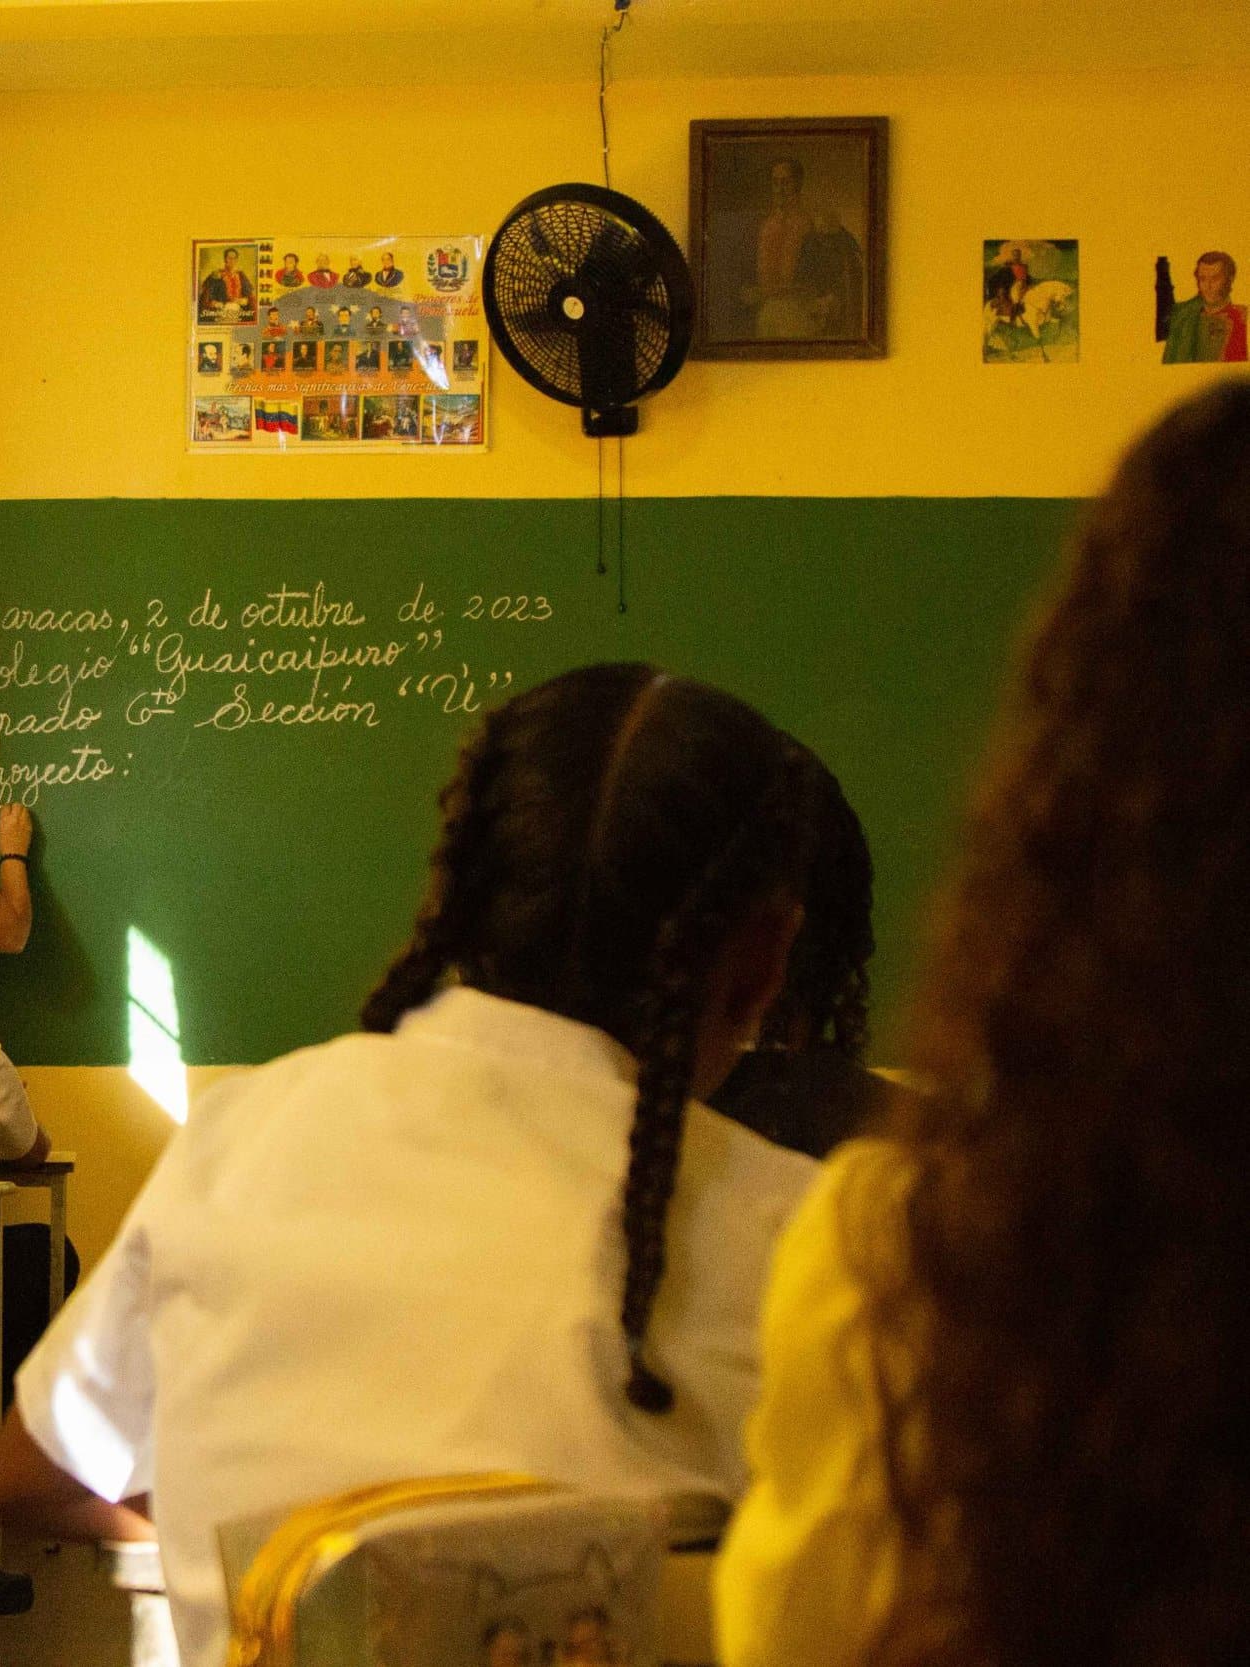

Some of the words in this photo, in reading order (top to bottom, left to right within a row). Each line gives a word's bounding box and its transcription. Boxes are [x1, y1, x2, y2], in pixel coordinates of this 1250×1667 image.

[146, 599, 168, 628] 2
[189, 588, 228, 630] de
[241, 580, 366, 628] octubre
[397, 582, 442, 624] de
[461, 595, 554, 622] 2023
[194, 675, 381, 731] Sección
